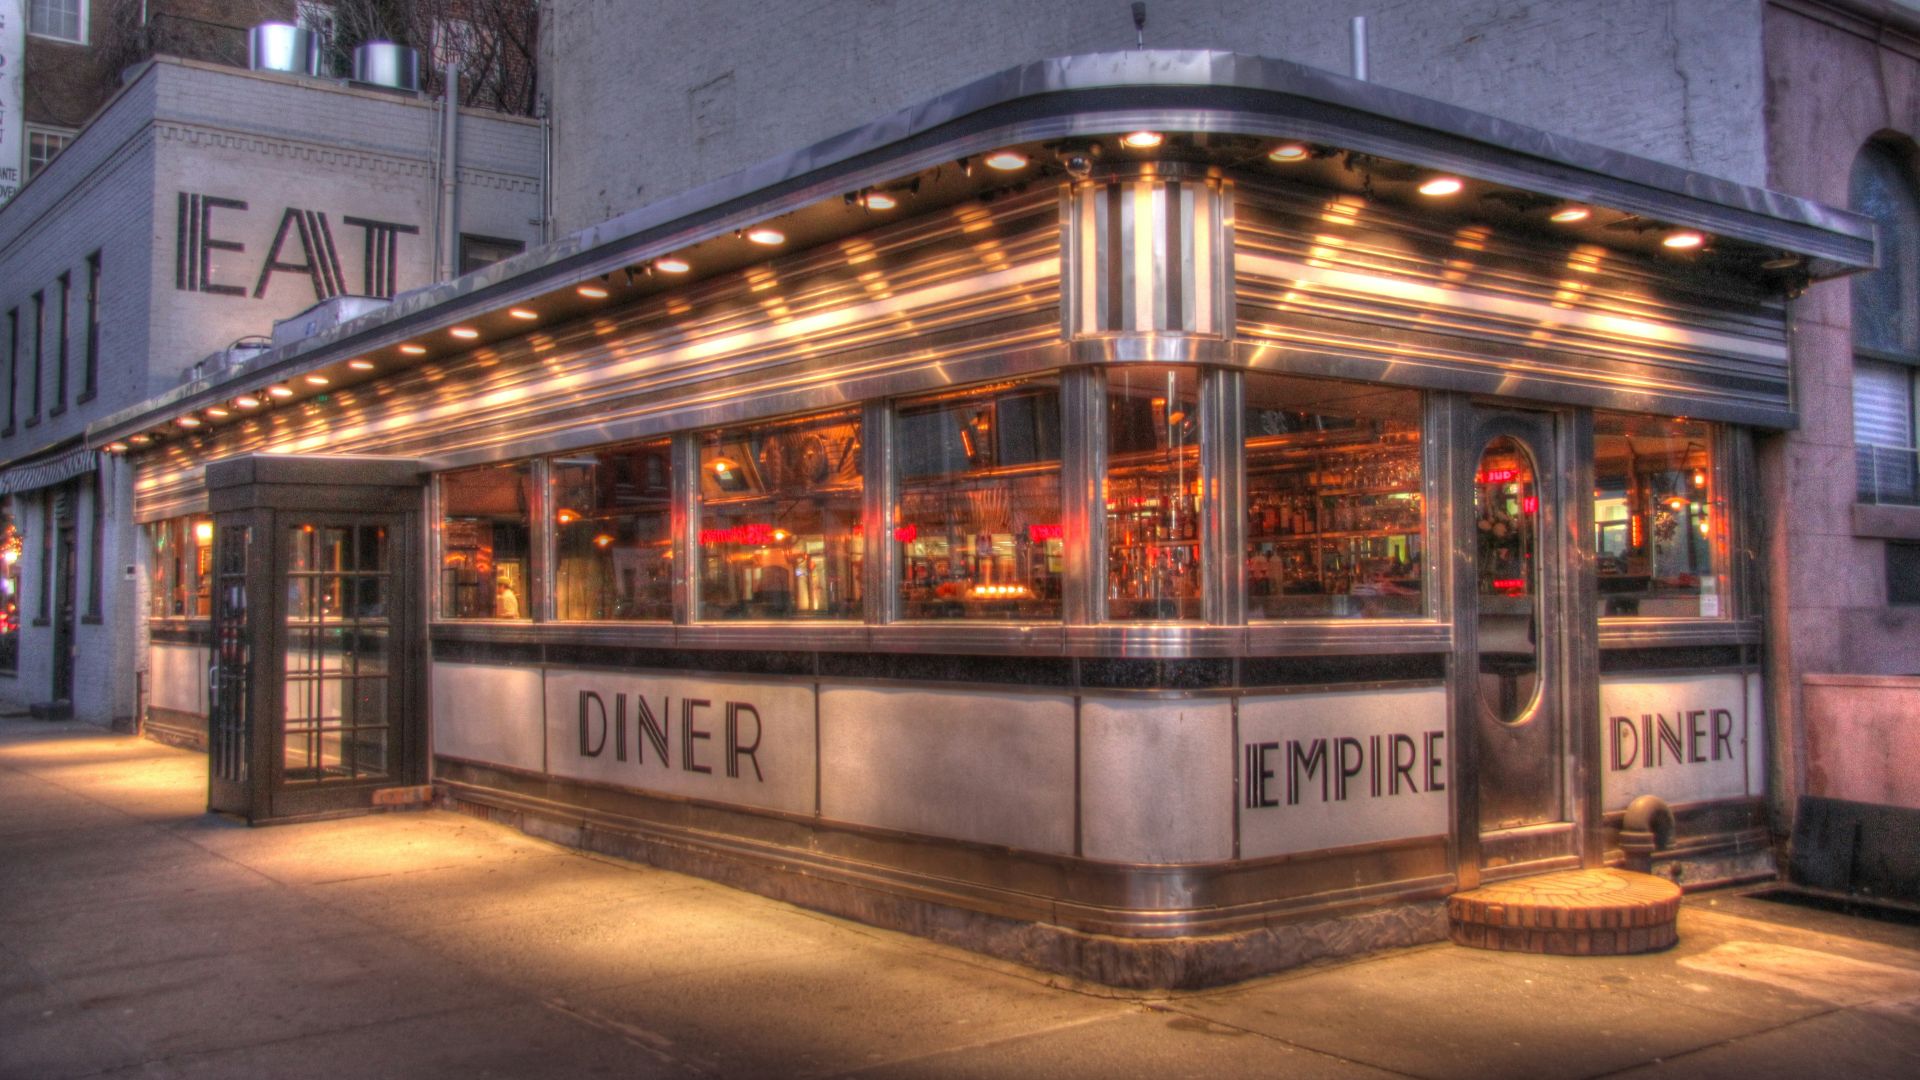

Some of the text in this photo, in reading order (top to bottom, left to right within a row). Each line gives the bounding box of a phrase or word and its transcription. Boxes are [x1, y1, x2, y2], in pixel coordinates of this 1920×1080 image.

[176, 191, 420, 300] EAT
[579, 690, 764, 783] DINER
[1245, 708, 1734, 809] EMPIRE DINER
